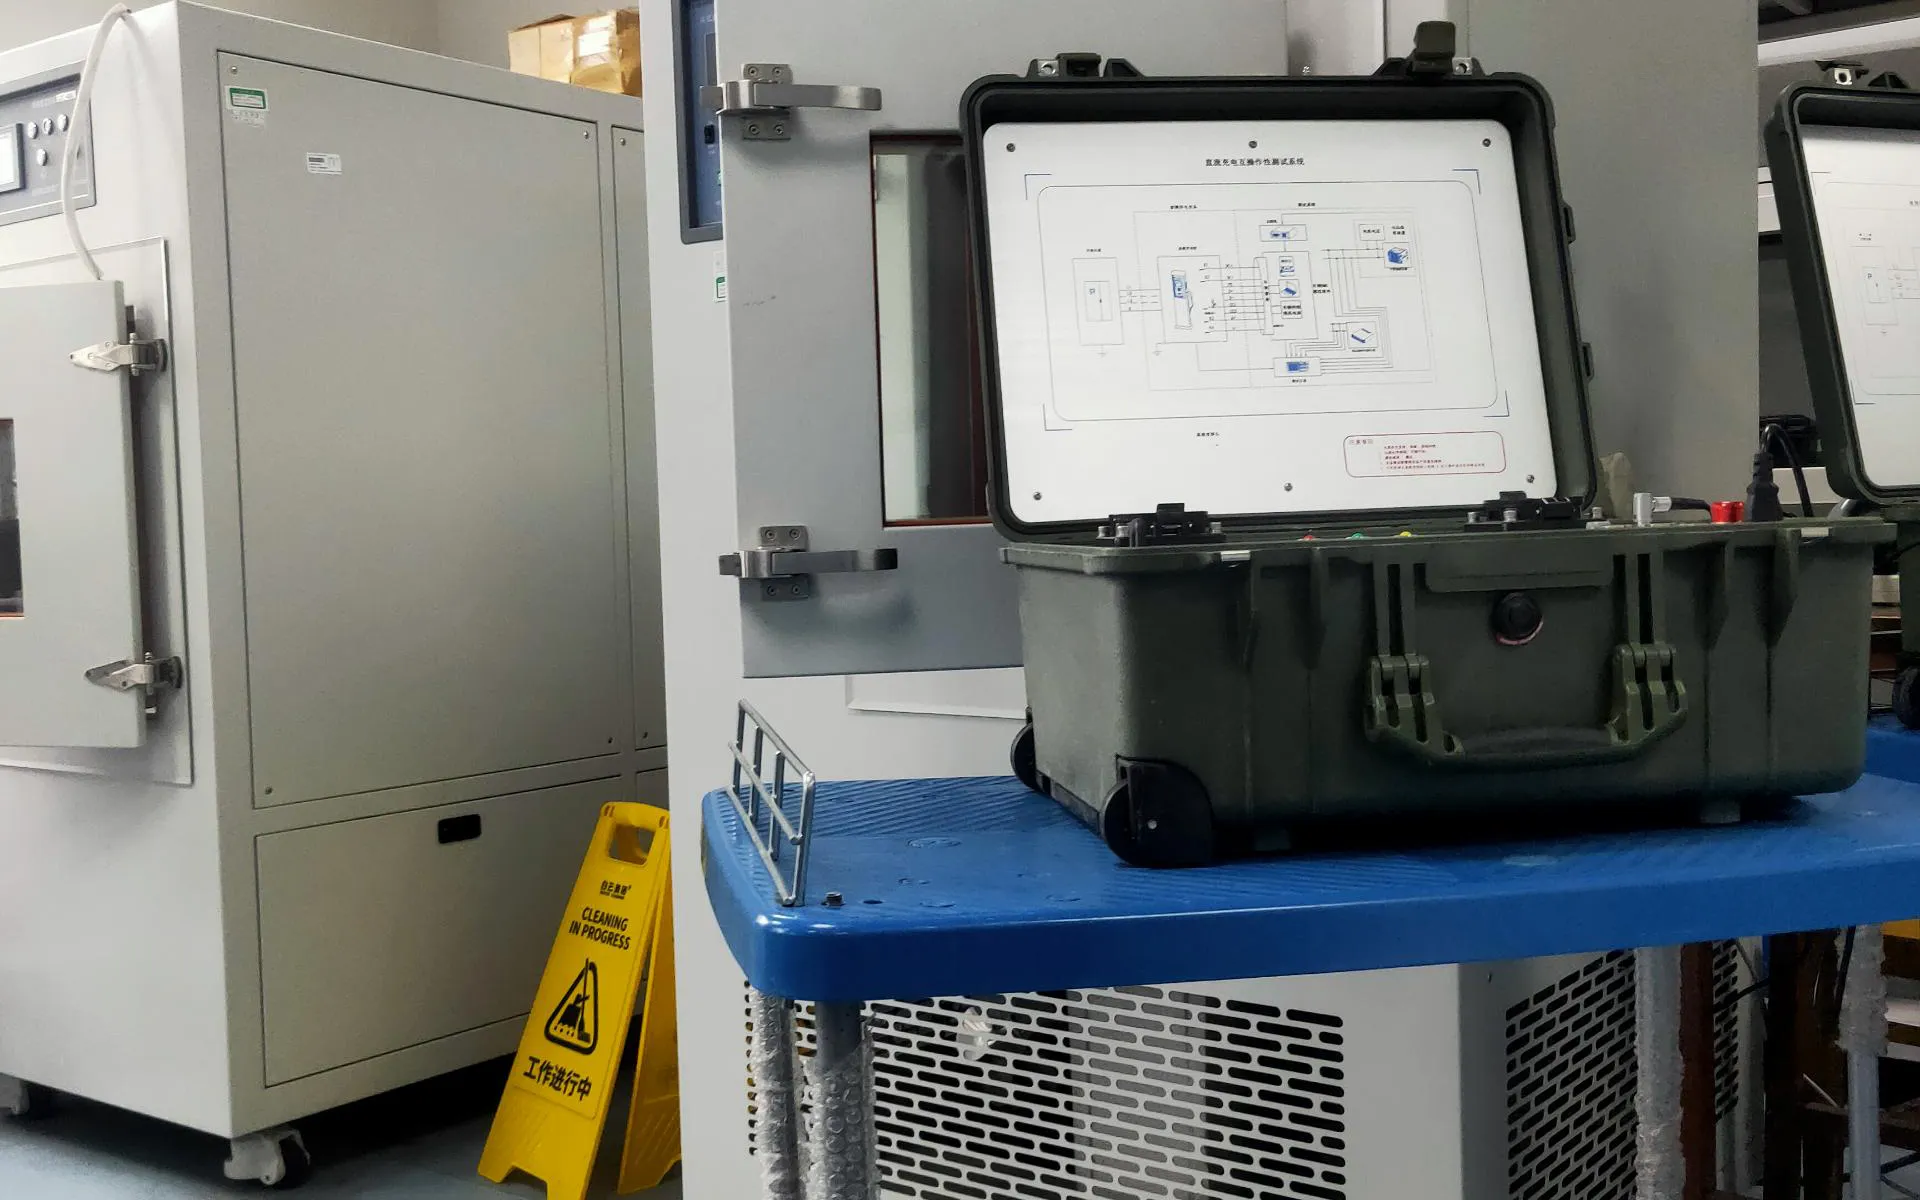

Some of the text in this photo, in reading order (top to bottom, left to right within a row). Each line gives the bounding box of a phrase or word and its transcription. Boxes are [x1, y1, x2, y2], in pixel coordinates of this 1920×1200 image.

[581, 906, 629, 932] CLEANING
[568, 920, 631, 950] IN PROGRESS
[523, 1055, 592, 1101] 工作进行中
